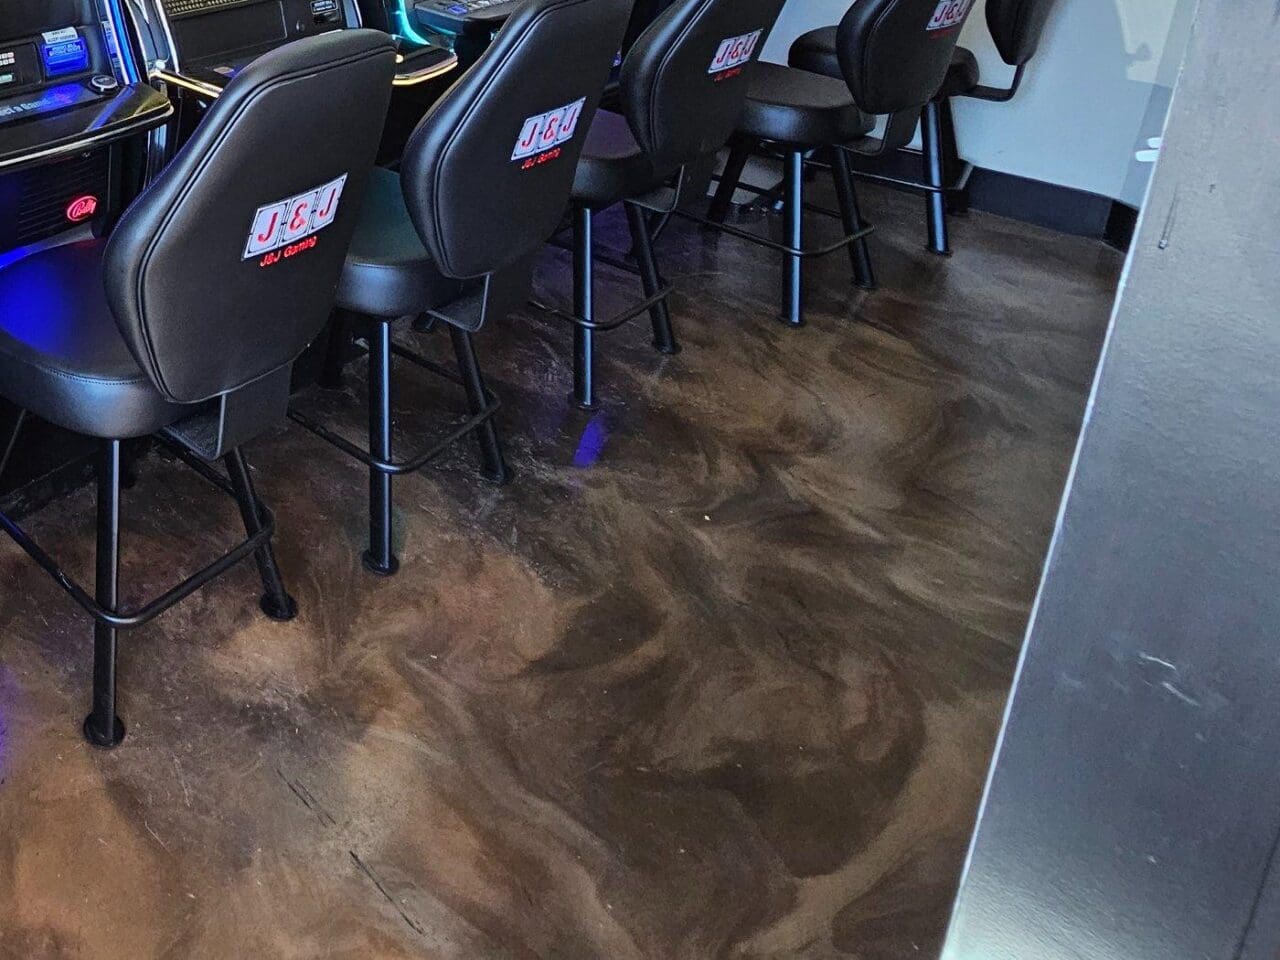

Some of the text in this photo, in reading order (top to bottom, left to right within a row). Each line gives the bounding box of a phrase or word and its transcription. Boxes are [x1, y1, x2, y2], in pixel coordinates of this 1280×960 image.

[518, 103, 581, 151] J&J
[251, 181, 342, 249] J&J
[260, 236, 318, 268] J&J Gaming
